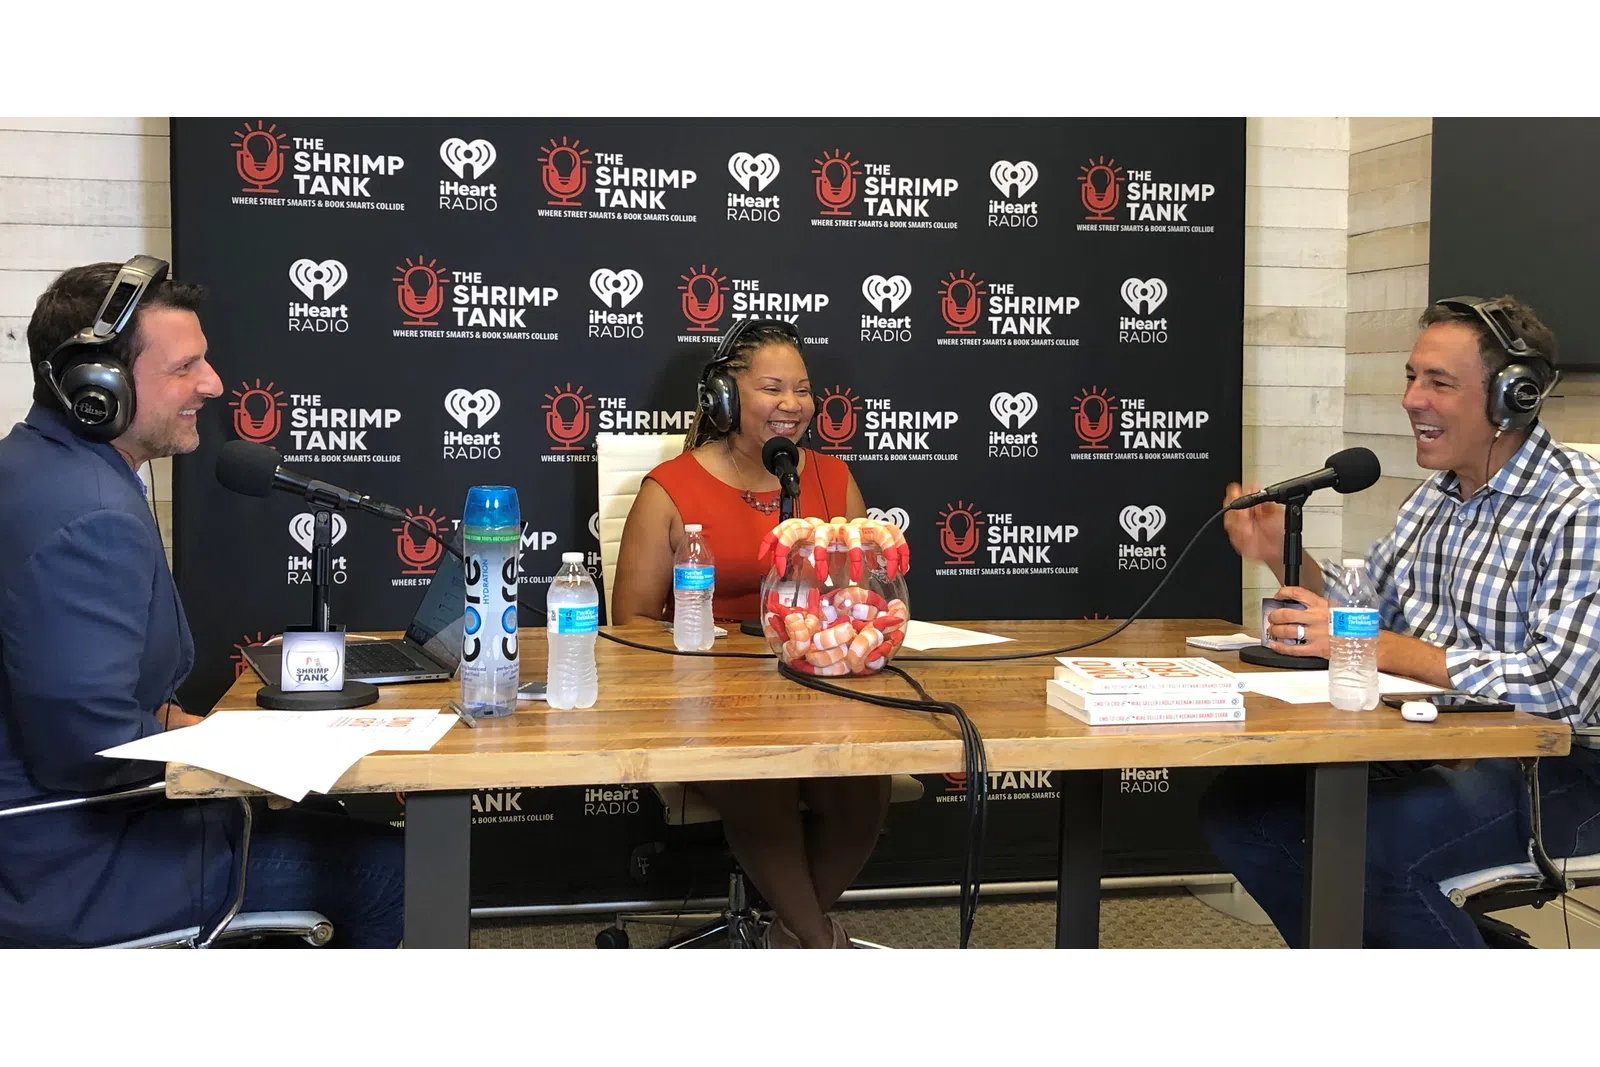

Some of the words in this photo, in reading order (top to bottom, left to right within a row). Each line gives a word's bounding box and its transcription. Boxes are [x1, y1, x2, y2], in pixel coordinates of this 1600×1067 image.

[293, 138, 324, 150] THE
[294, 152, 404, 175] SHRIMP
[595, 153, 623, 165] THE
[864, 164, 890, 175] THE
[1127, 170, 1151, 181] THE
[596, 166, 697, 188] SHRIMP
[294, 174, 371, 197] TANK
[440, 180, 496, 197] iHeart
[865, 176, 958, 196] SHRIMP
[1127, 182, 1214, 201] SHRIMP
[231, 196, 258, 205] WHERE
[259, 197, 285, 206] STREET
[286, 198, 316, 207] SMARTS
[317, 199, 323, 207] &
[324, 199, 344, 208] BOOK
[345, 200, 375, 209] SMARTS
[375, 202, 404, 211] COLLIDE
[440, 196, 497, 211] RADIO
[595, 188, 666, 209] TANK
[728, 193, 780, 208] iHeart
[864, 198, 929, 217] TANK
[989, 200, 1037, 214] iHeart
[1126, 203, 1187, 221] TANK
[537, 208, 562, 217] WHERE
[563, 209, 587, 218] STREET
[588, 210, 615, 219] SMARTS
[623, 212, 642, 220] BOOK
[642, 213, 669, 221] SMARTS
[670, 214, 696, 222] COLLIDE
[728, 208, 780, 222] RADIO
[989, 215, 1038, 227] RADIO
[810, 218, 833, 226] WHERE
[834, 219, 856, 227] STREET
[857, 219, 882, 228] SMARTS
[907, 220, 932, 228] SMARTS
[932, 221, 957, 229] COLLIDE
[452, 272, 482, 283] THE
[732, 280, 759, 290] THE
[989, 284, 1014, 294] THE
[453, 285, 558, 306] SHRIMP
[733, 292, 829, 312] SHRIMP
[289, 302, 348, 318] iHeart
[989, 296, 1080, 314] SHRIMP
[452, 307, 526, 328] TANK
[590, 310, 643, 324] iHeart
[862, 314, 911, 328] iHeart
[1120, 317, 1167, 330] iHeart
[289, 318, 348, 332] RADIO
[589, 325, 644, 338] RADIO
[988, 317, 1051, 334] TANK
[392, 329, 418, 337] WHERE
[419, 329, 444, 338] STREET
[445, 330, 474, 338] SMARTS
[482, 331, 501, 339] BOOK
[502, 331, 530, 340] SMARTS
[530, 332, 558, 340] COLLIDE
[861, 330, 911, 342] RADIO
[1120, 331, 1167, 343] RADIO
[290, 395, 321, 406] THE
[598, 398, 626, 408] THE
[865, 399, 890, 409] THE
[1120, 399, 1144, 409] THE
[291, 408, 401, 428] SHRIMP
[599, 410, 696, 429] SHRIMP
[866, 411, 958, 429] SHRIMP
[1121, 411, 1209, 428] SHRIMP
[290, 431, 367, 450] TANK
[444, 430, 500, 445] iHeart
[864, 432, 929, 450] TANK
[989, 431, 1037, 444] iHeart
[1120, 431, 1182, 448] TANK
[444, 446, 500, 459] RADIO
[989, 446, 1038, 457] RADIO
[987, 514, 1012, 524] THE
[988, 526, 1078, 544] SHRIMP
[987, 546, 1050, 564] TANK
[1119, 544, 1166, 557] iHeart
[1119, 558, 1166, 570] RADIO
[463, 556, 481, 663] core
[502, 556, 518, 663] core
[988, 770, 1052, 790] TANK
[1121, 768, 1168, 780] iHeart
[1121, 781, 1169, 793] RADIO
[472, 792, 522, 812] ANK
[585, 789, 638, 802] iHeart
[585, 801, 639, 815] RADIO
